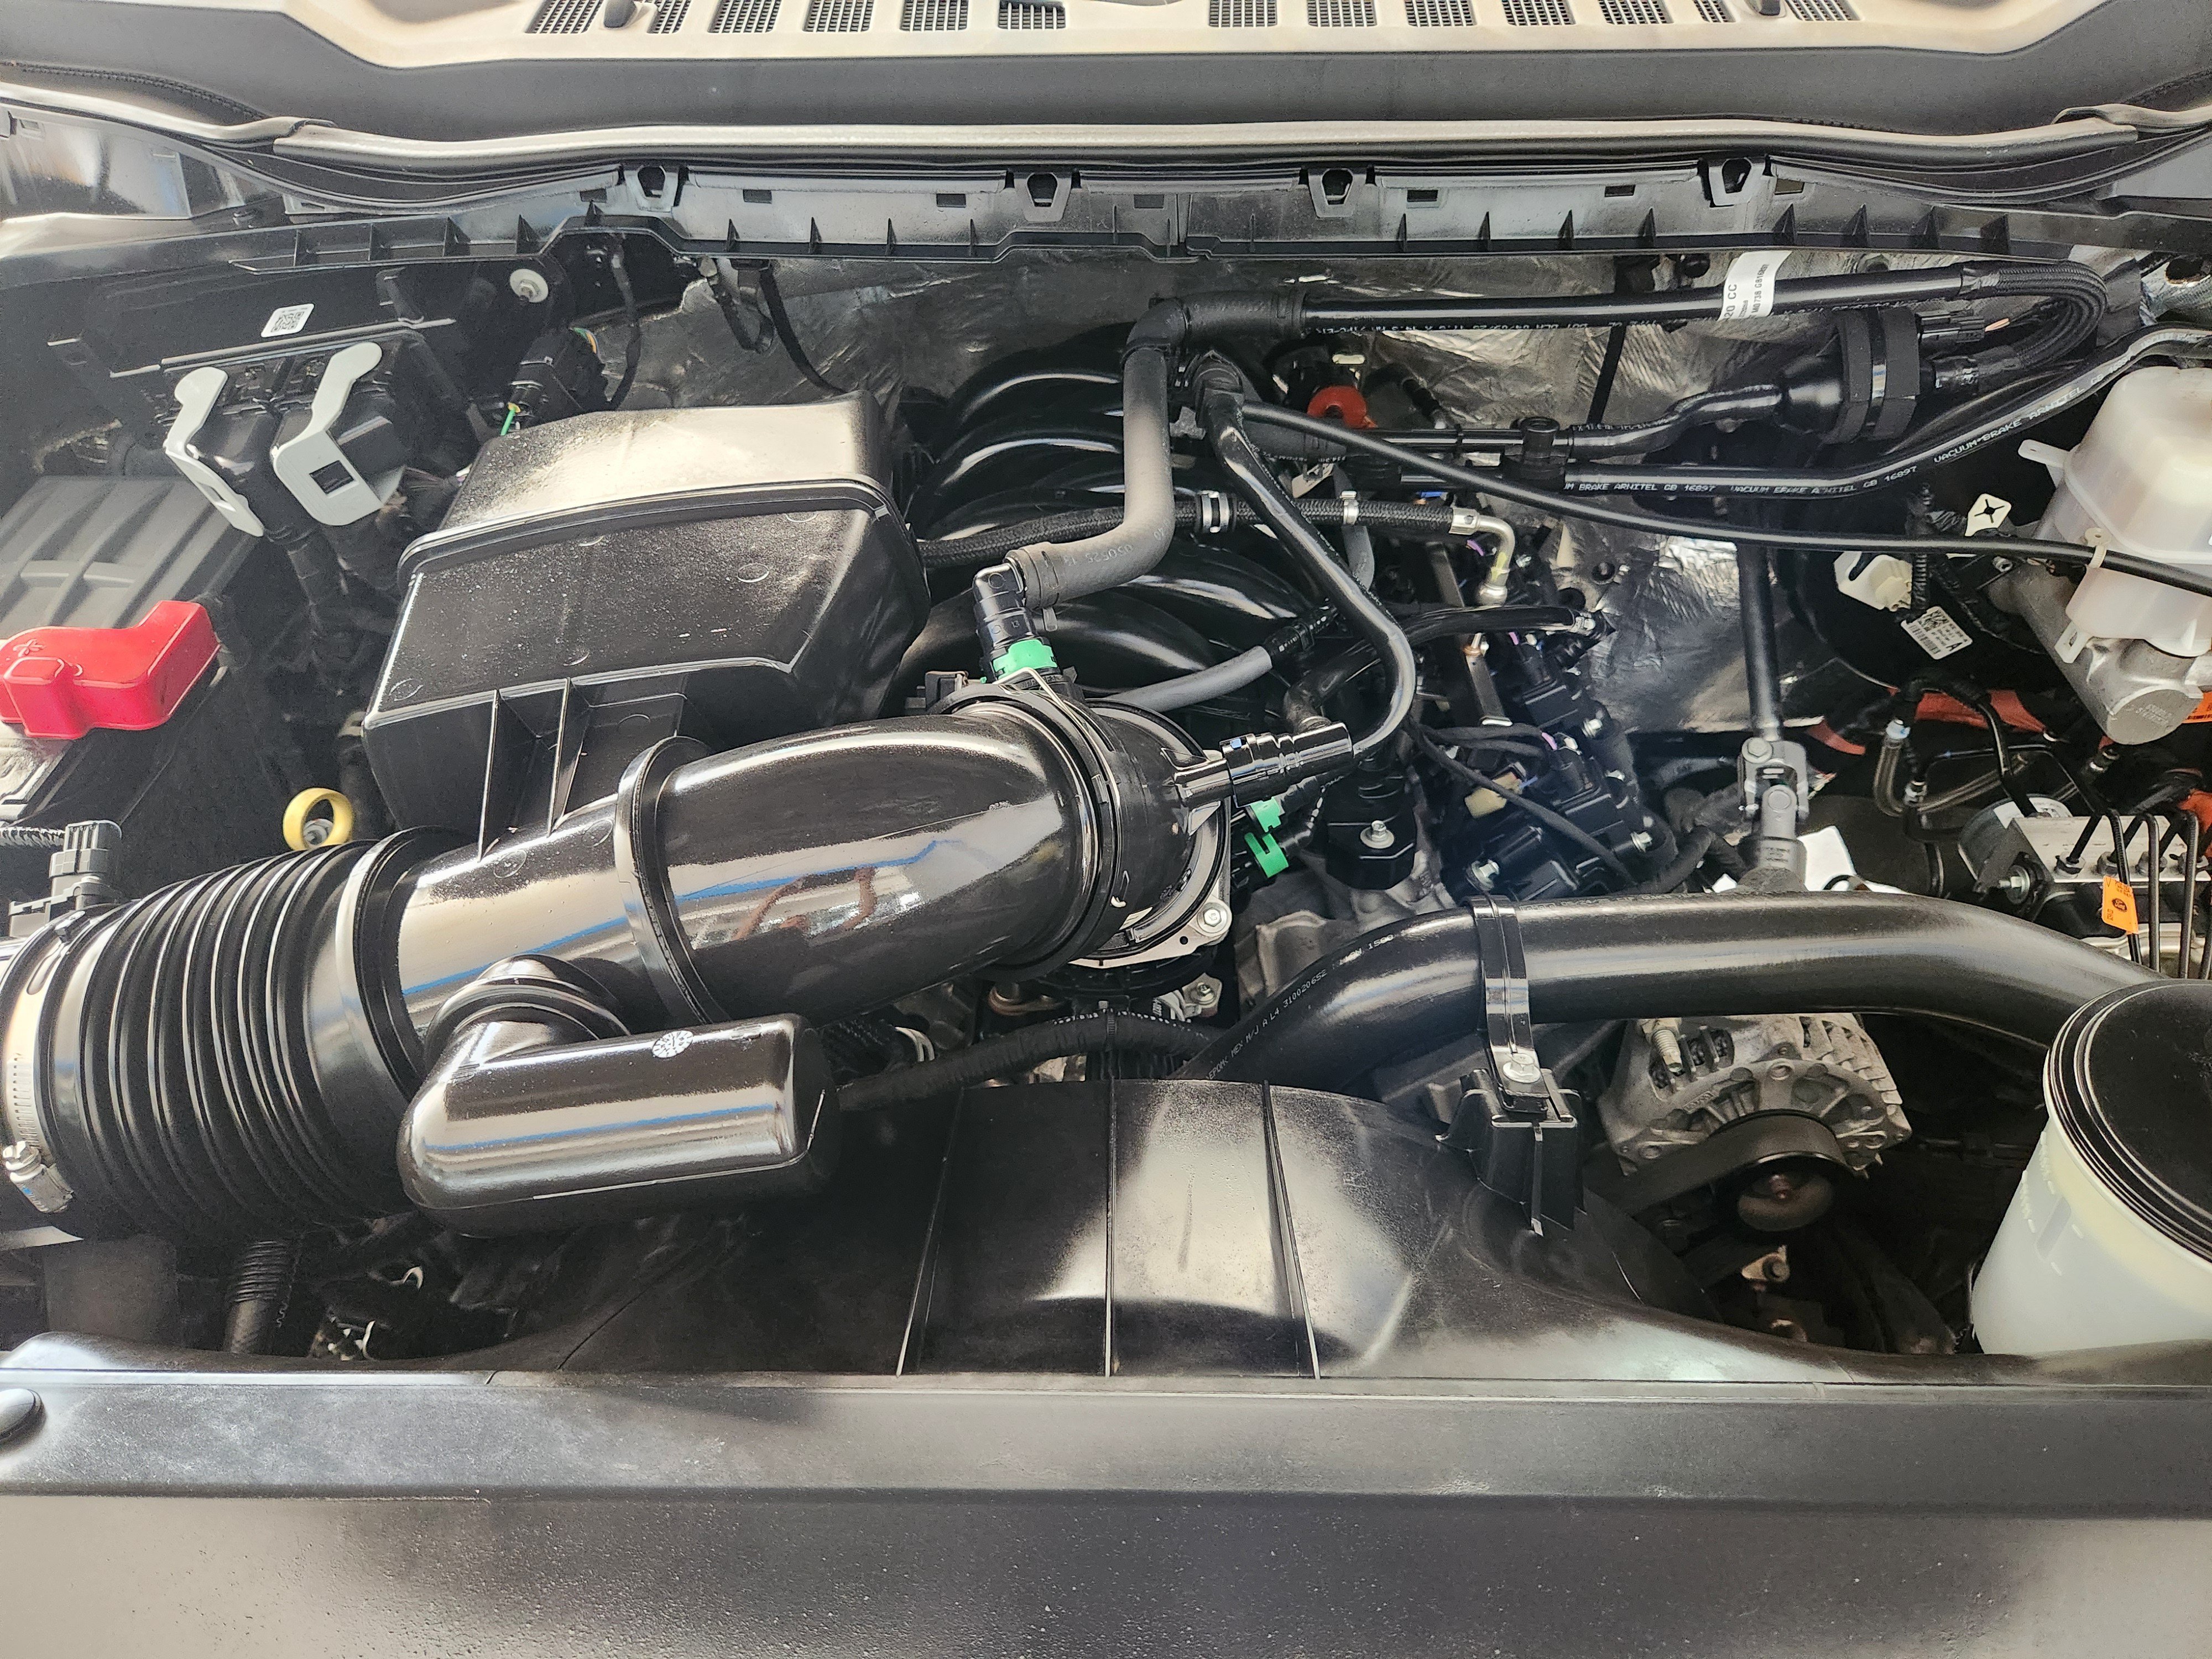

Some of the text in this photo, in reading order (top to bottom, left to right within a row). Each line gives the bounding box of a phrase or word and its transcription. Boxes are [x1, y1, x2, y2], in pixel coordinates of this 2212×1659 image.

[1724, 284, 1737, 320] 20 CC
[1884, 466, 1918, 482] 16897
[1578, 483, 1610, 491] BRAKE
[1262, 1019, 1269, 1027] A
